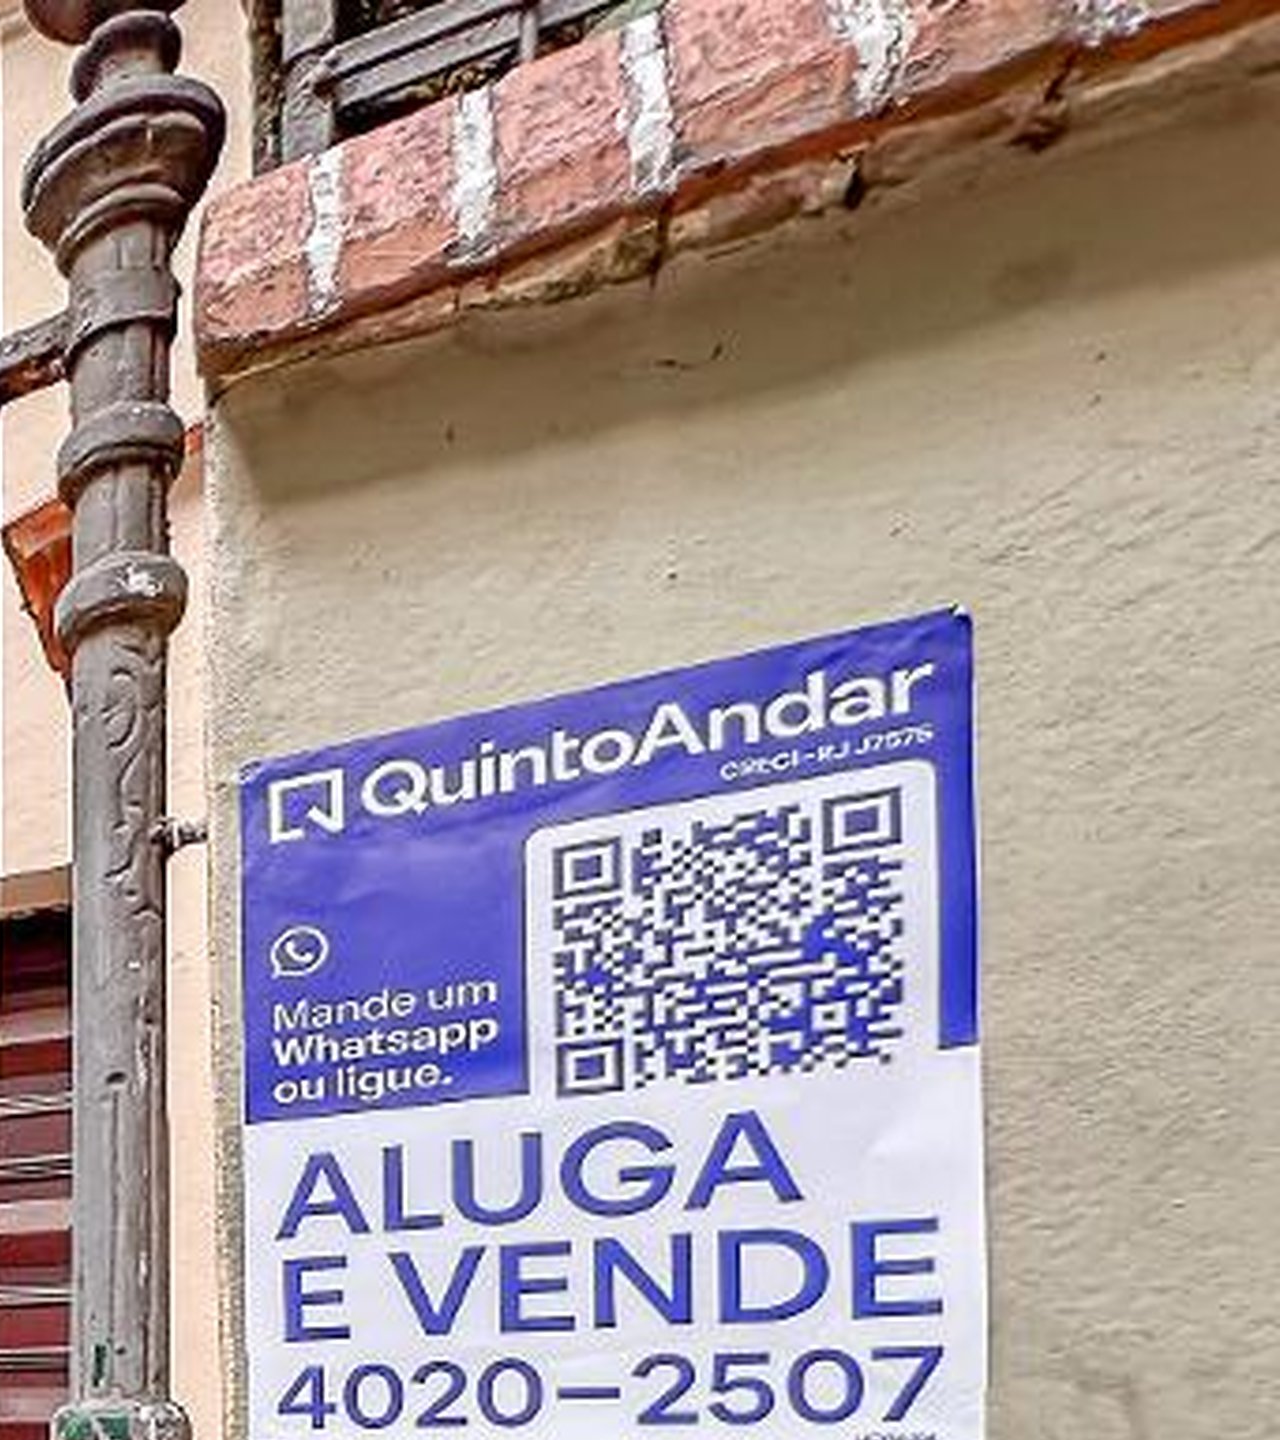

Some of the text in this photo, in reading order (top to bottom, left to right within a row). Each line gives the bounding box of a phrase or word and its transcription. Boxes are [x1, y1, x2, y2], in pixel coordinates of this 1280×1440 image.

[362, 662, 934, 815] QuintoAndar
[720, 741, 851, 781] CRECI-RJ
[273, 980, 498, 1033] Mande um
[272, 1017, 499, 1066] Whatsapp
[273, 1063, 453, 1104] ou ligue.
[276, 1109, 806, 1241] ALUGA
[282, 1217, 944, 1342] E VENDE
[277, 1345, 945, 1429] 4020-2507
